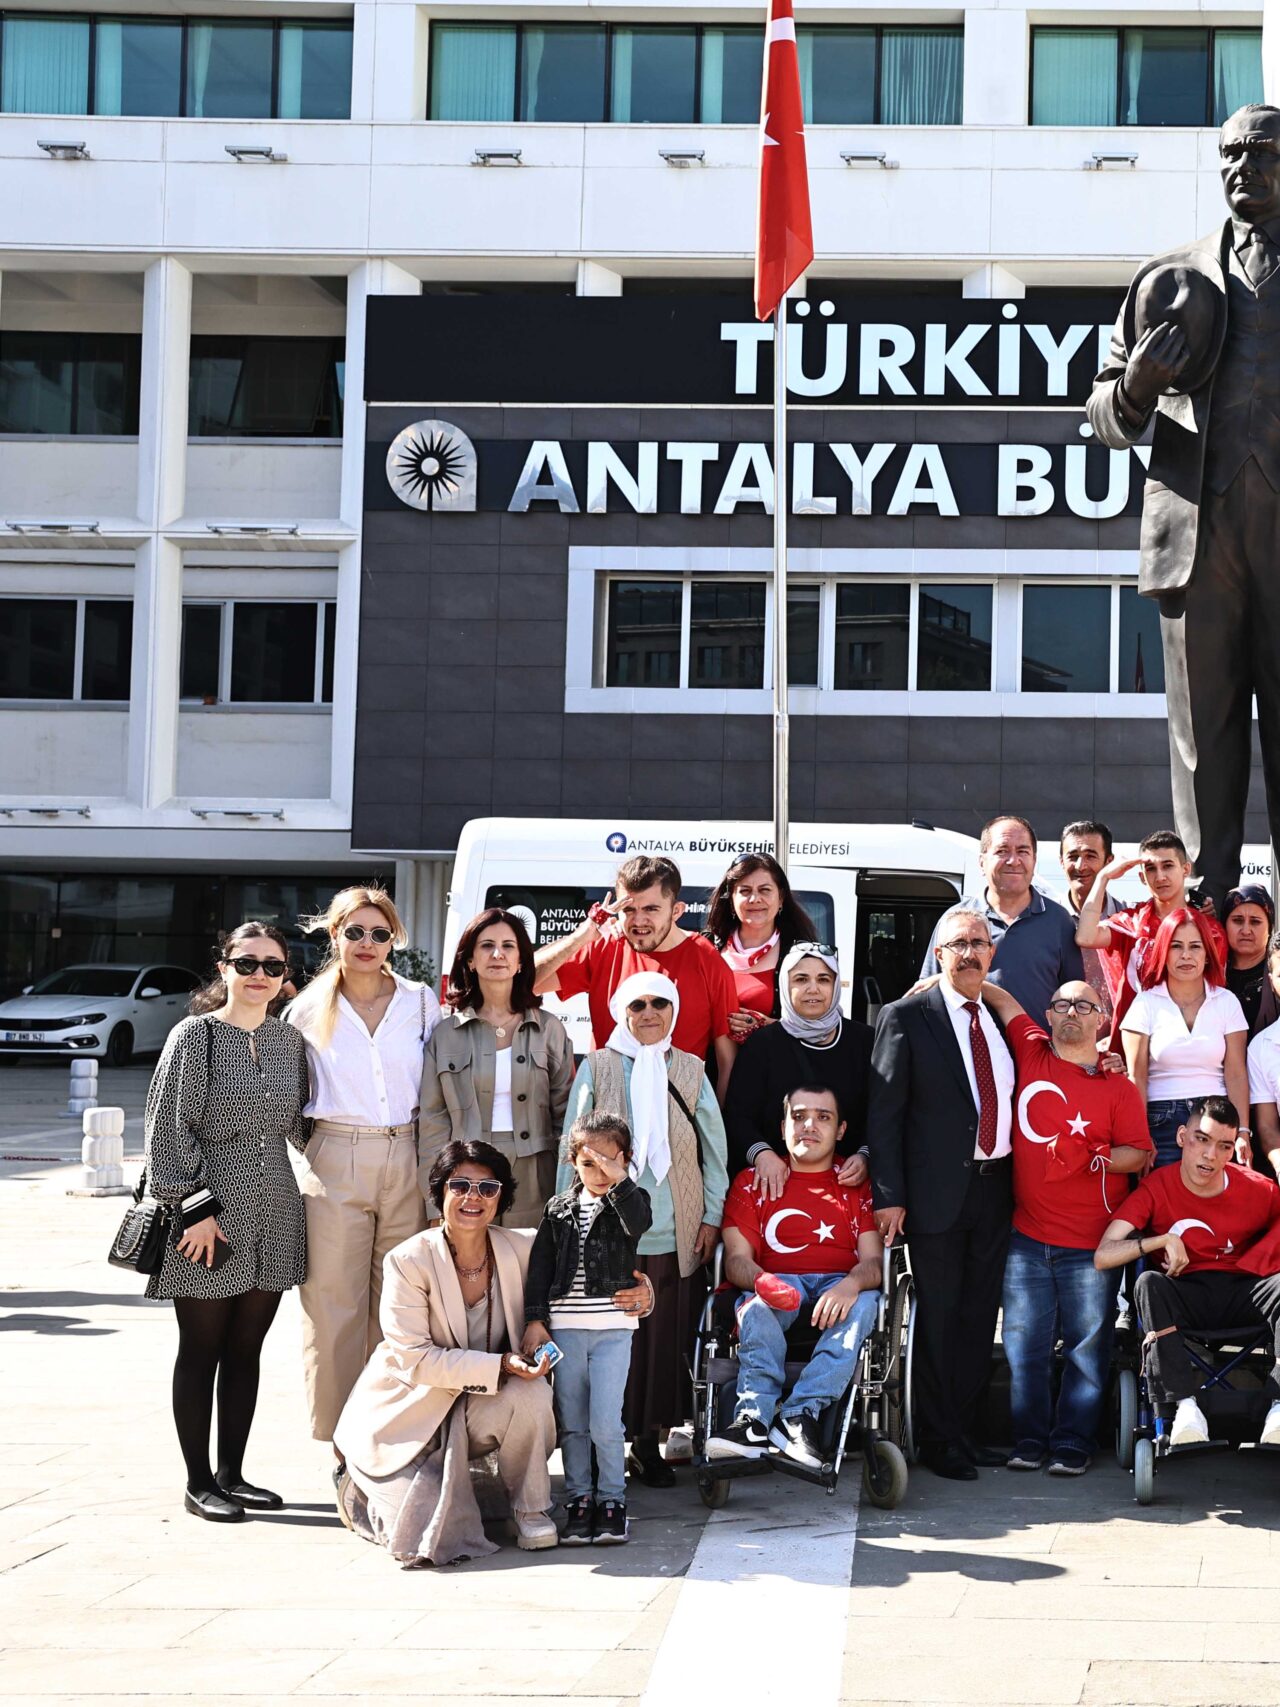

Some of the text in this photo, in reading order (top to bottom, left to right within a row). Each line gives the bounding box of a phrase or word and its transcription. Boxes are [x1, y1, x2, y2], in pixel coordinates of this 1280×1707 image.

[507, 441, 960, 516] ANTALYA
[628, 839, 684, 852] ANTALYA
[789, 841, 850, 856] ELEDİYESİ
[541, 908, 587, 919] ANTALYA
[541, 919, 578, 932] BÜYÜK
